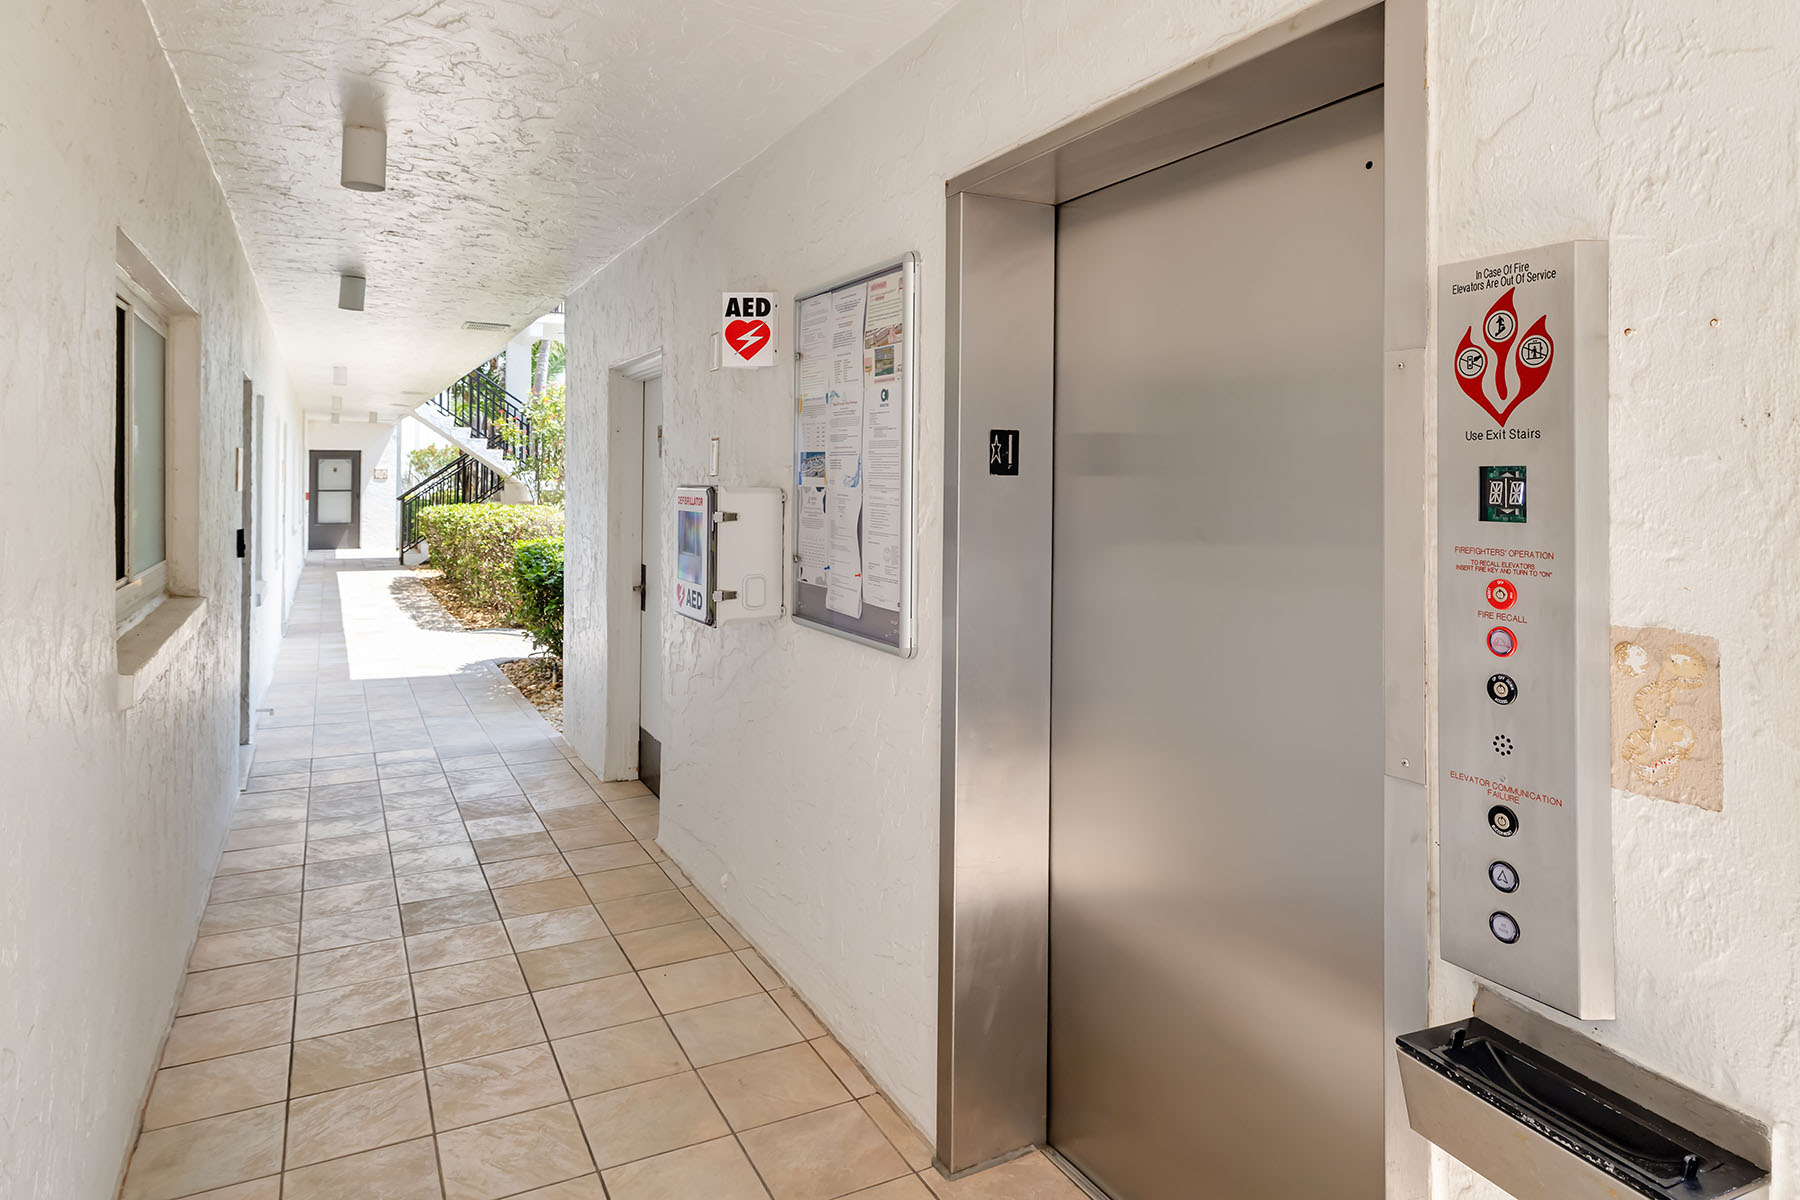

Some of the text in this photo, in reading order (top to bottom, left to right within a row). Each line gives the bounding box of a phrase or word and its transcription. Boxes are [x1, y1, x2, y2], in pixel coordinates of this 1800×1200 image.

[1475, 262, 1530, 280] In Case Of Fire
[1452, 269, 1557, 295] Elevators Are Out Of Service
[724, 297, 772, 318] AED
[1465, 428, 1541, 441] Use Exit Stairs
[1454, 546, 1555, 560] FIREFIGHTERS' OPERATION
[1479, 559, 1500, 568] RECALL
[1501, 561, 1536, 570] ELEVATORS
[1512, 568, 1529, 576] TURN
[686, 588, 703, 610] AED
[1477, 610, 1528, 624] FIRE RECALL
[1449, 770, 1563, 807] ELEVATOR COMMUNICATION
[1487, 788, 1520, 805] FAILURE
